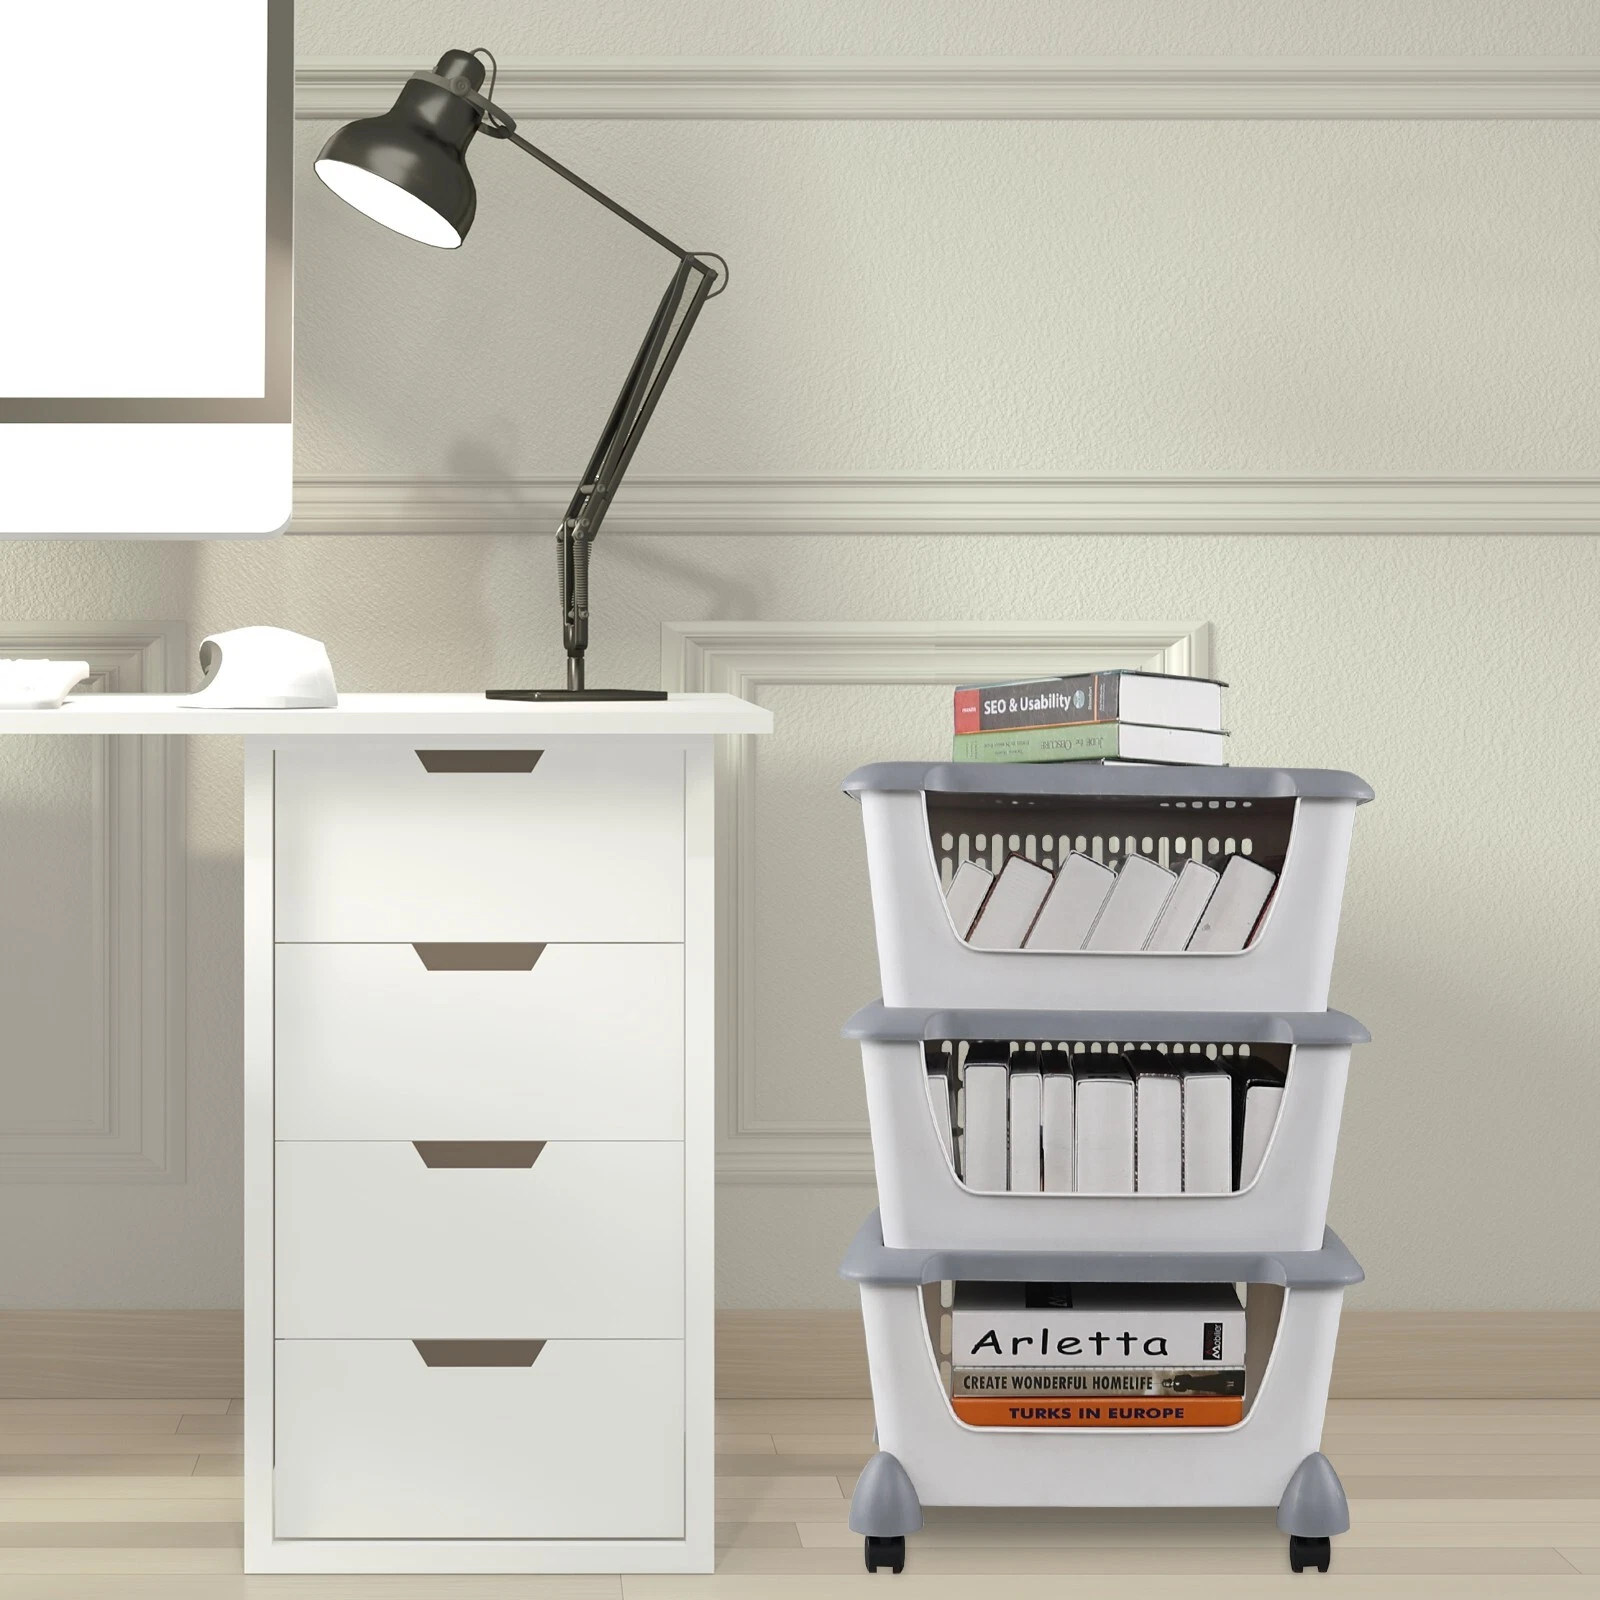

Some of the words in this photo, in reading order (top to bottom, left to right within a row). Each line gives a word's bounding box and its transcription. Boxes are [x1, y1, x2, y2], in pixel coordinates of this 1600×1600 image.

[984, 699, 1006, 715] SEO
[1009, 698, 1018, 713] &
[1020, 691, 1072, 711] Usability
[971, 1327, 1168, 1356] Arletta
[963, 1376, 1007, 1390] CREATE
[1012, 1376, 1088, 1390] WONDERFUL
[1093, 1376, 1153, 1390] HOMELIFE
[1009, 1408, 1071, 1419] TURKS
[1079, 1408, 1101, 1419] IN
[1108, 1408, 1185, 1419] EUROPE
